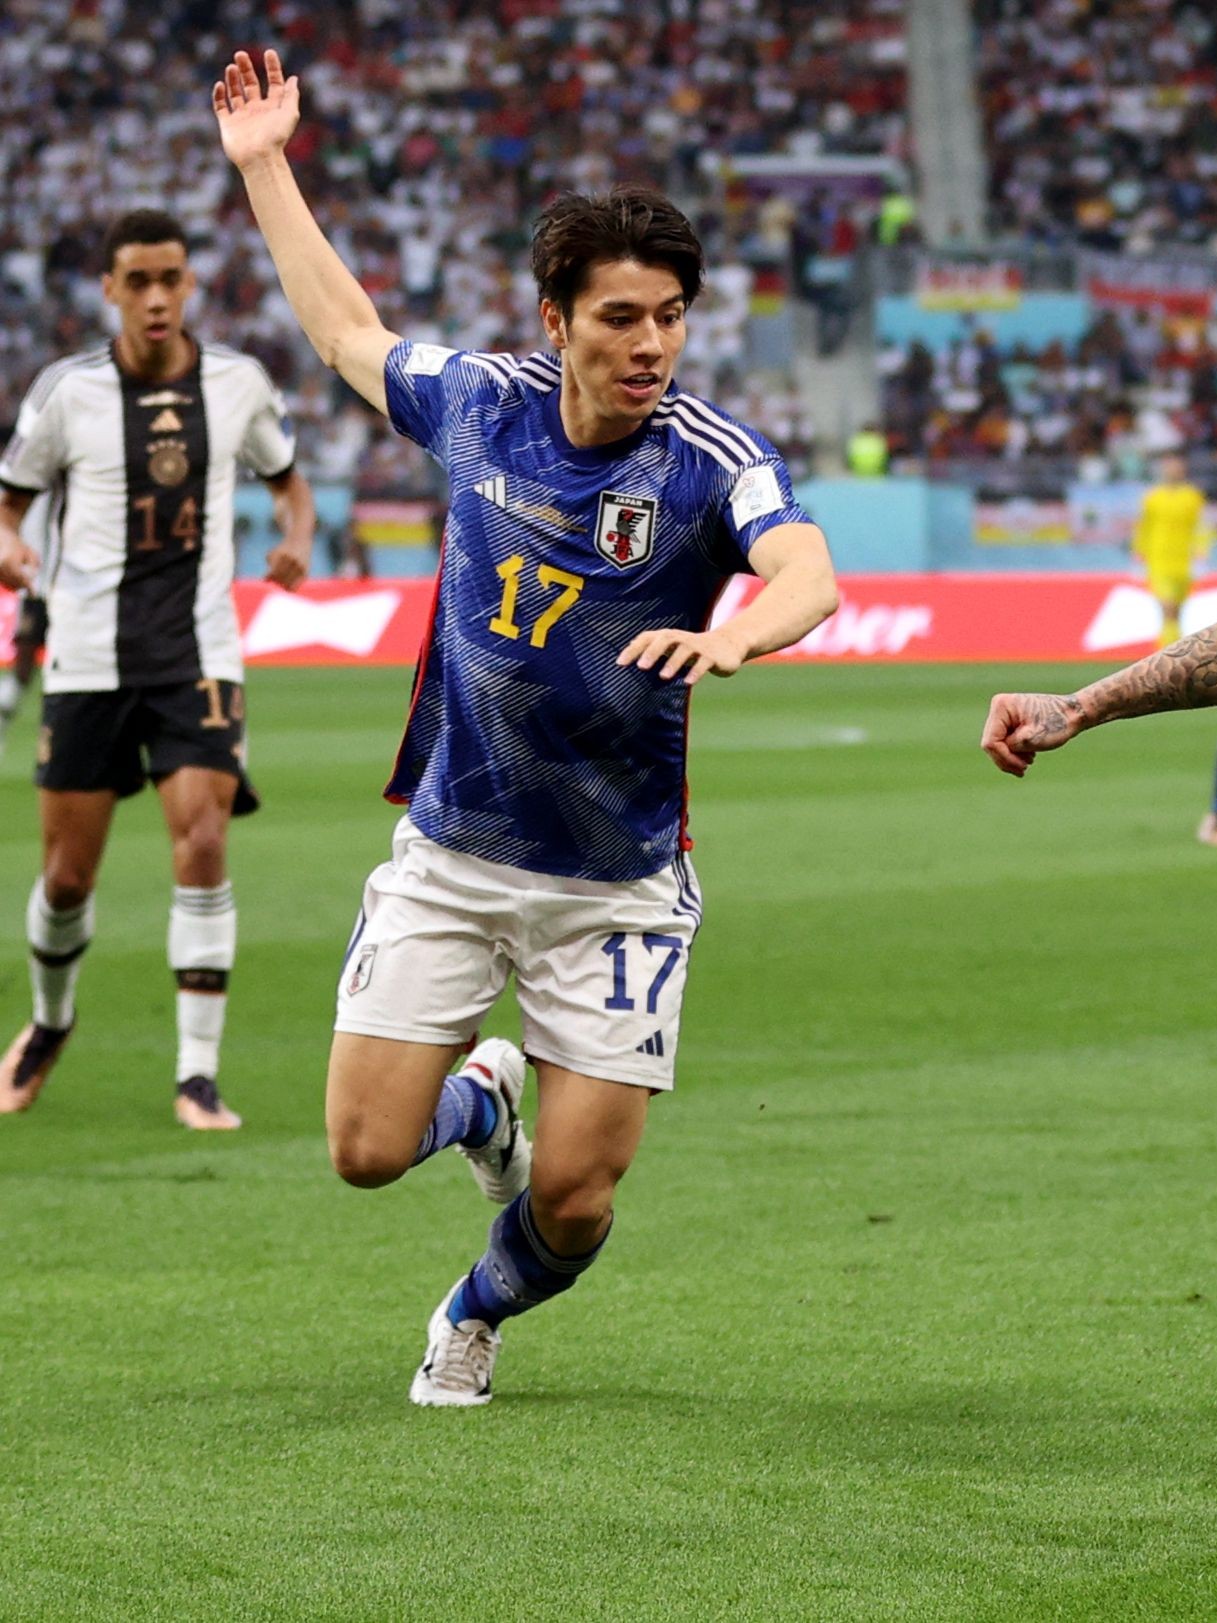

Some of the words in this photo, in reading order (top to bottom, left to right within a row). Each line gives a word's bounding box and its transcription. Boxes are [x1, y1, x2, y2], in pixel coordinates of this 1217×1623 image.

[134, 496, 198, 551] 14
[614, 496, 643, 506] JAPAN
[489, 554, 584, 648] 17
[602, 932, 683, 1014] 17
